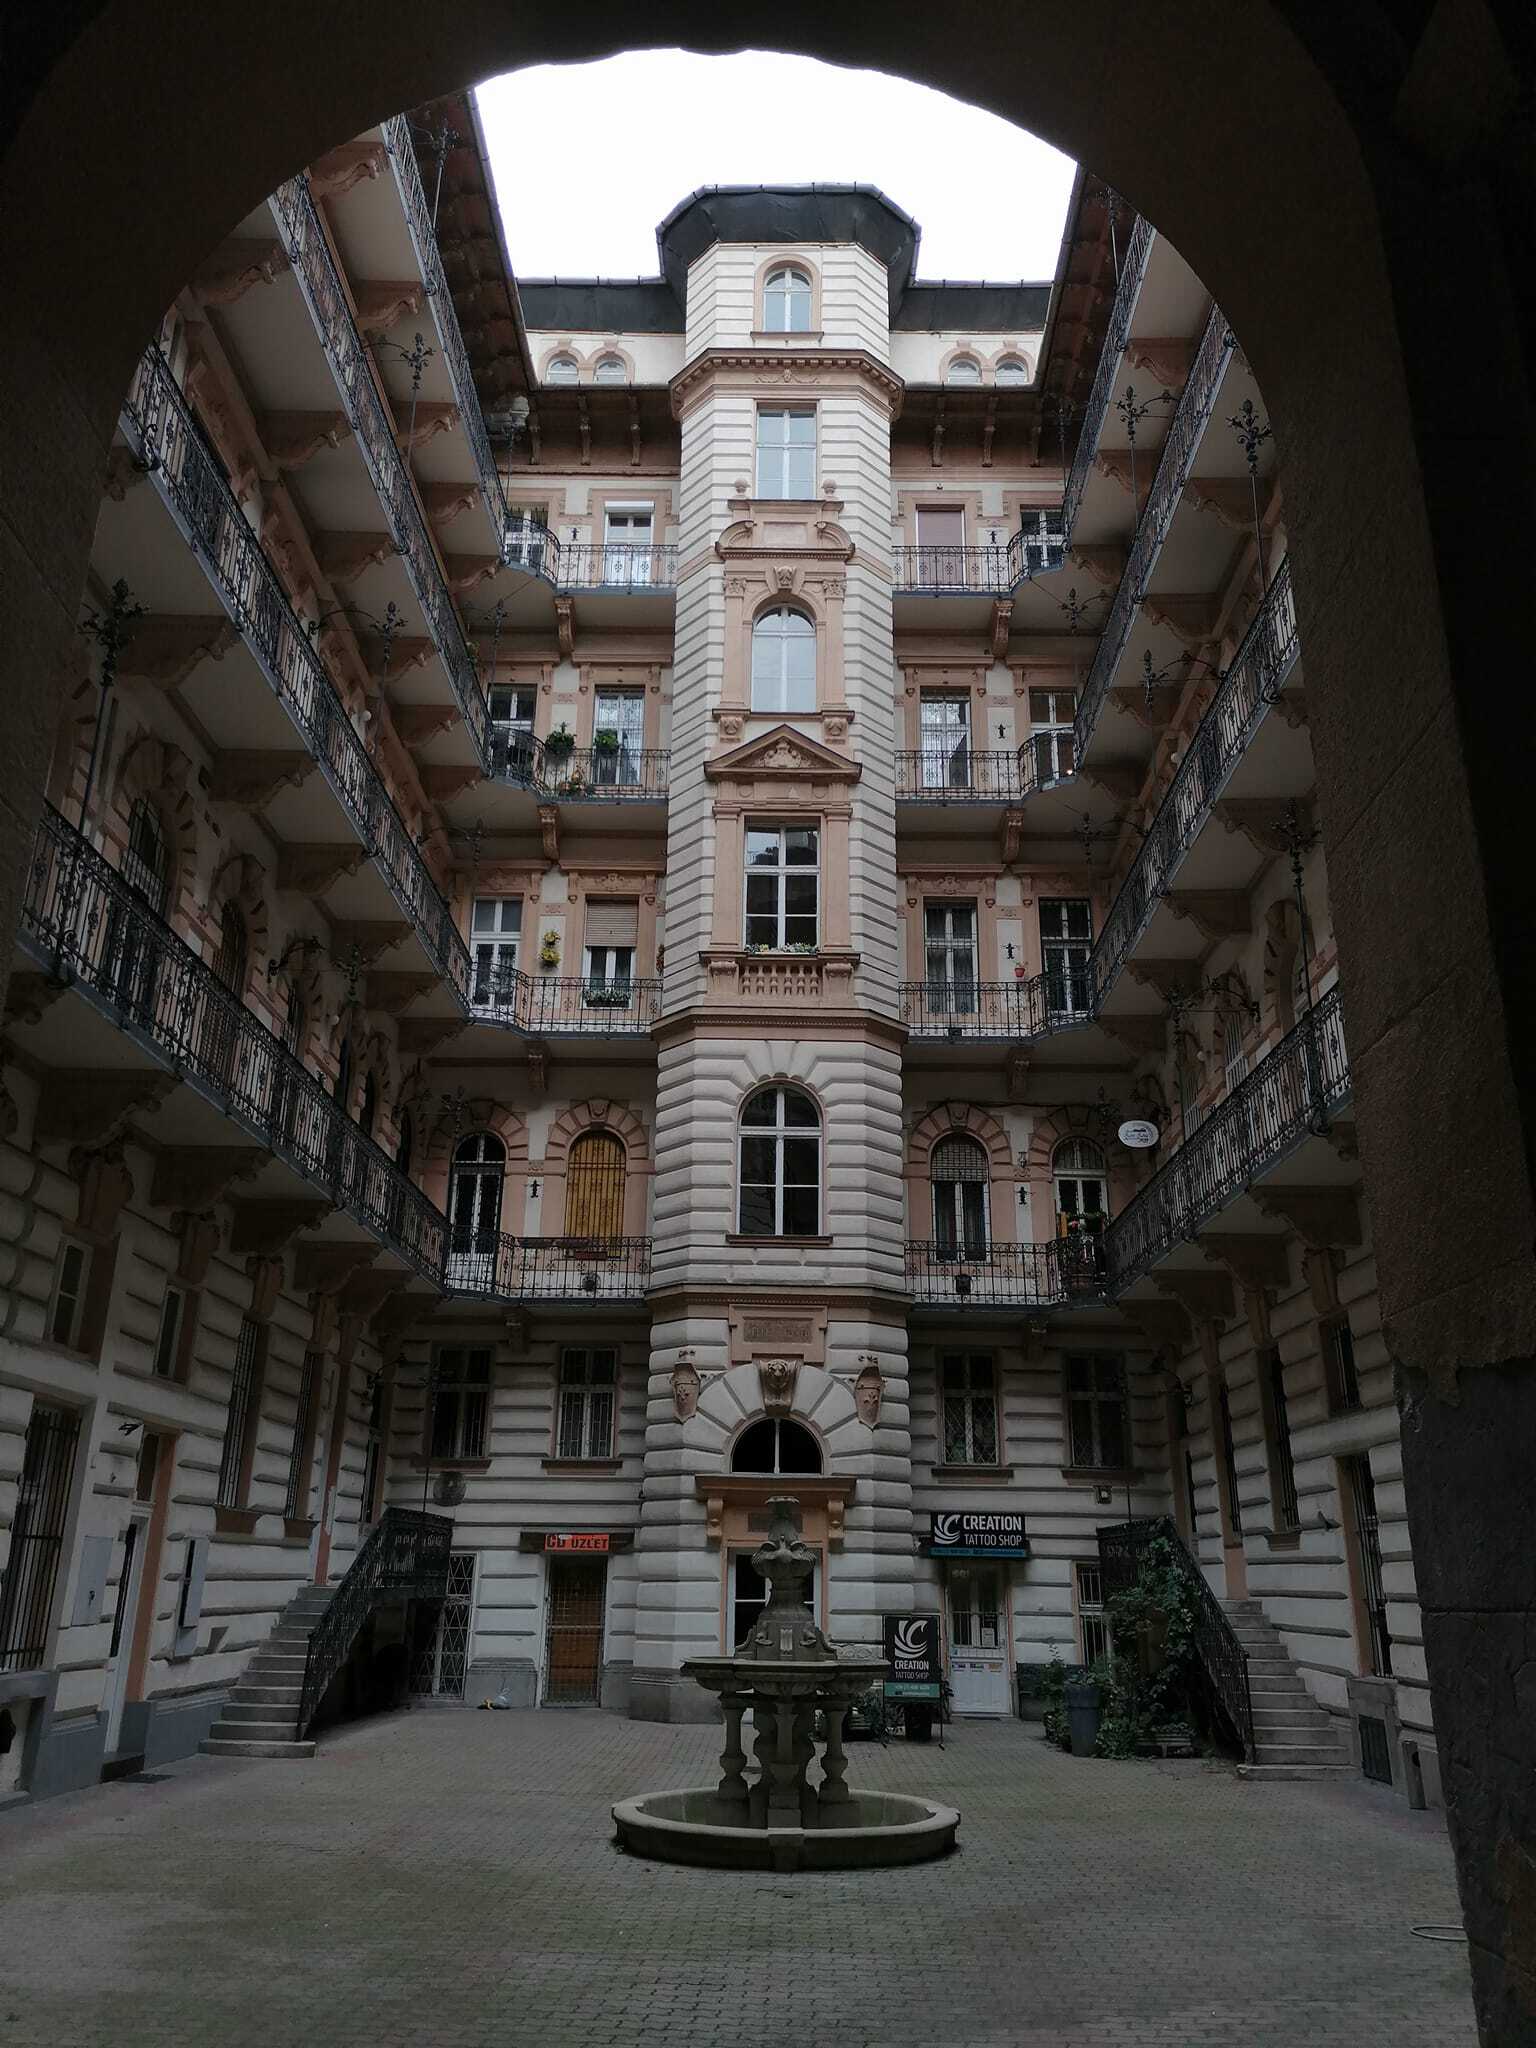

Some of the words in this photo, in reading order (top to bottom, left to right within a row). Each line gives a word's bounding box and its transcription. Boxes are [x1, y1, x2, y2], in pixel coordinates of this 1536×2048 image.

[963, 1515, 1022, 1531] CREATION
[963, 1534, 996, 1545] TATTOO
[998, 1534, 1022, 1546] SHOP
[894, 1660, 929, 1670] CREATION
[895, 1671, 914, 1679] TATTOO
[915, 1672, 929, 1680] SHOP
